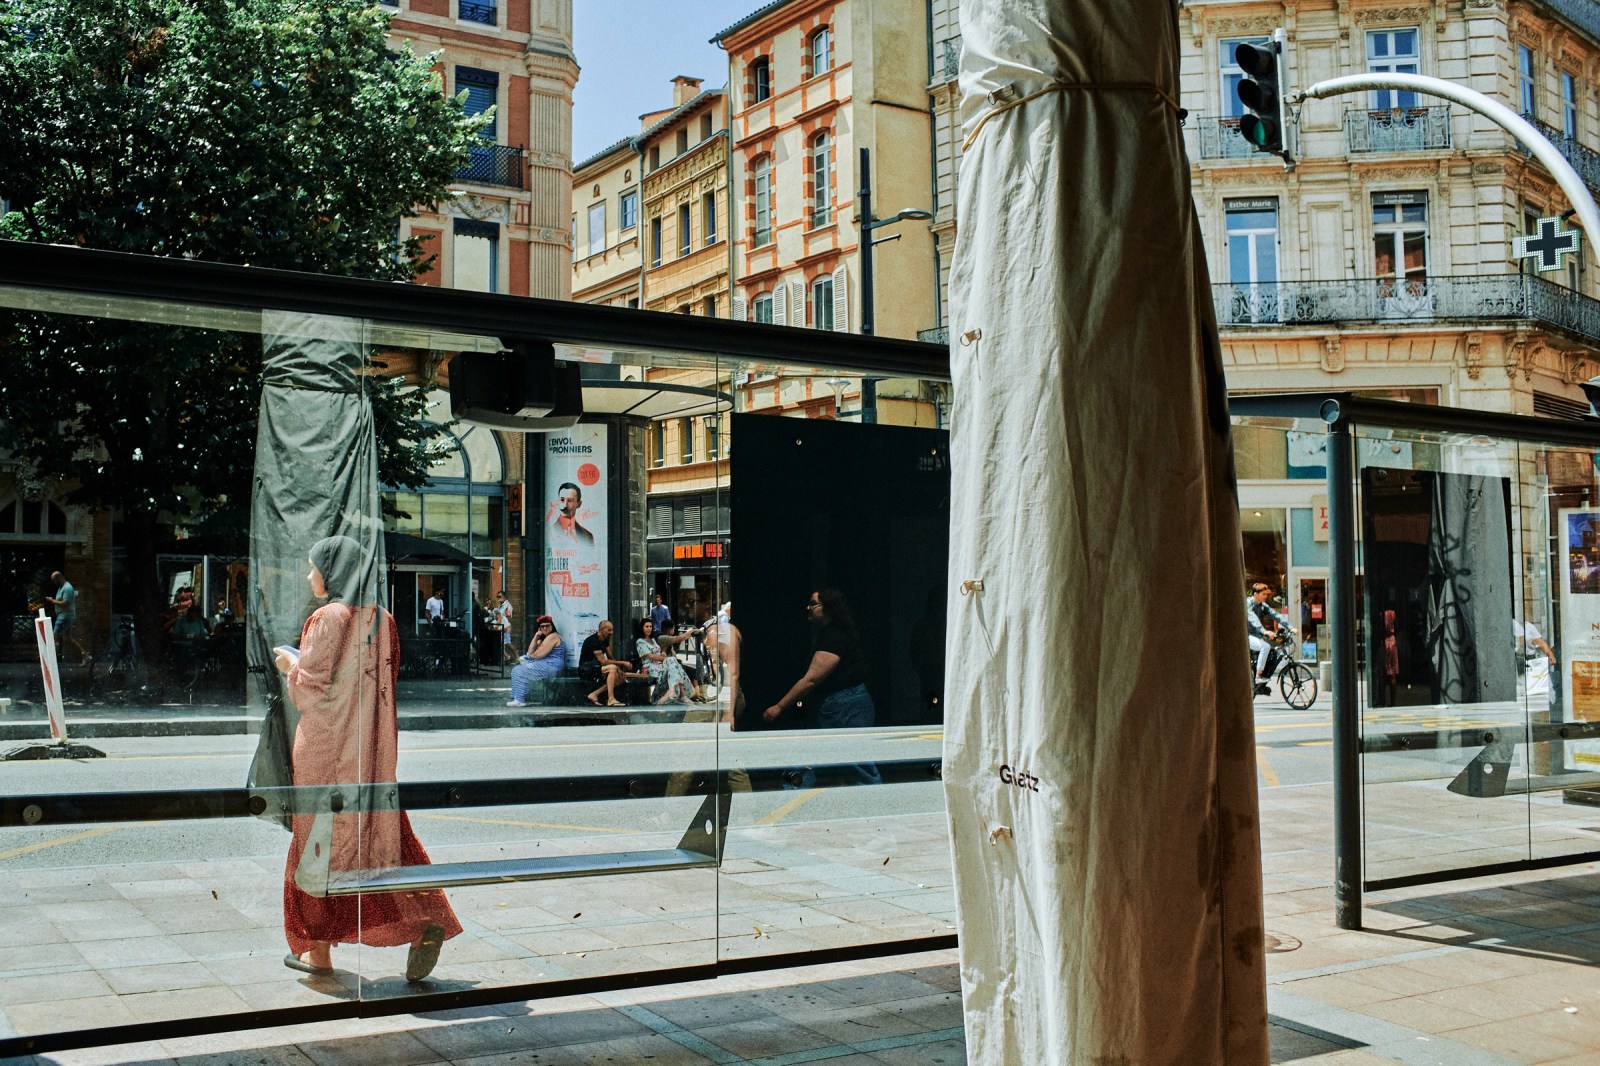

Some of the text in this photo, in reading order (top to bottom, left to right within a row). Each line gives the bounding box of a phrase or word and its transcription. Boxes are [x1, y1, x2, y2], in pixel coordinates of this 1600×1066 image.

[548, 437, 573, 446] L'ENVOL
[553, 445, 592, 454] PIONNIERS
[1000, 764, 1039, 792] Glatz
